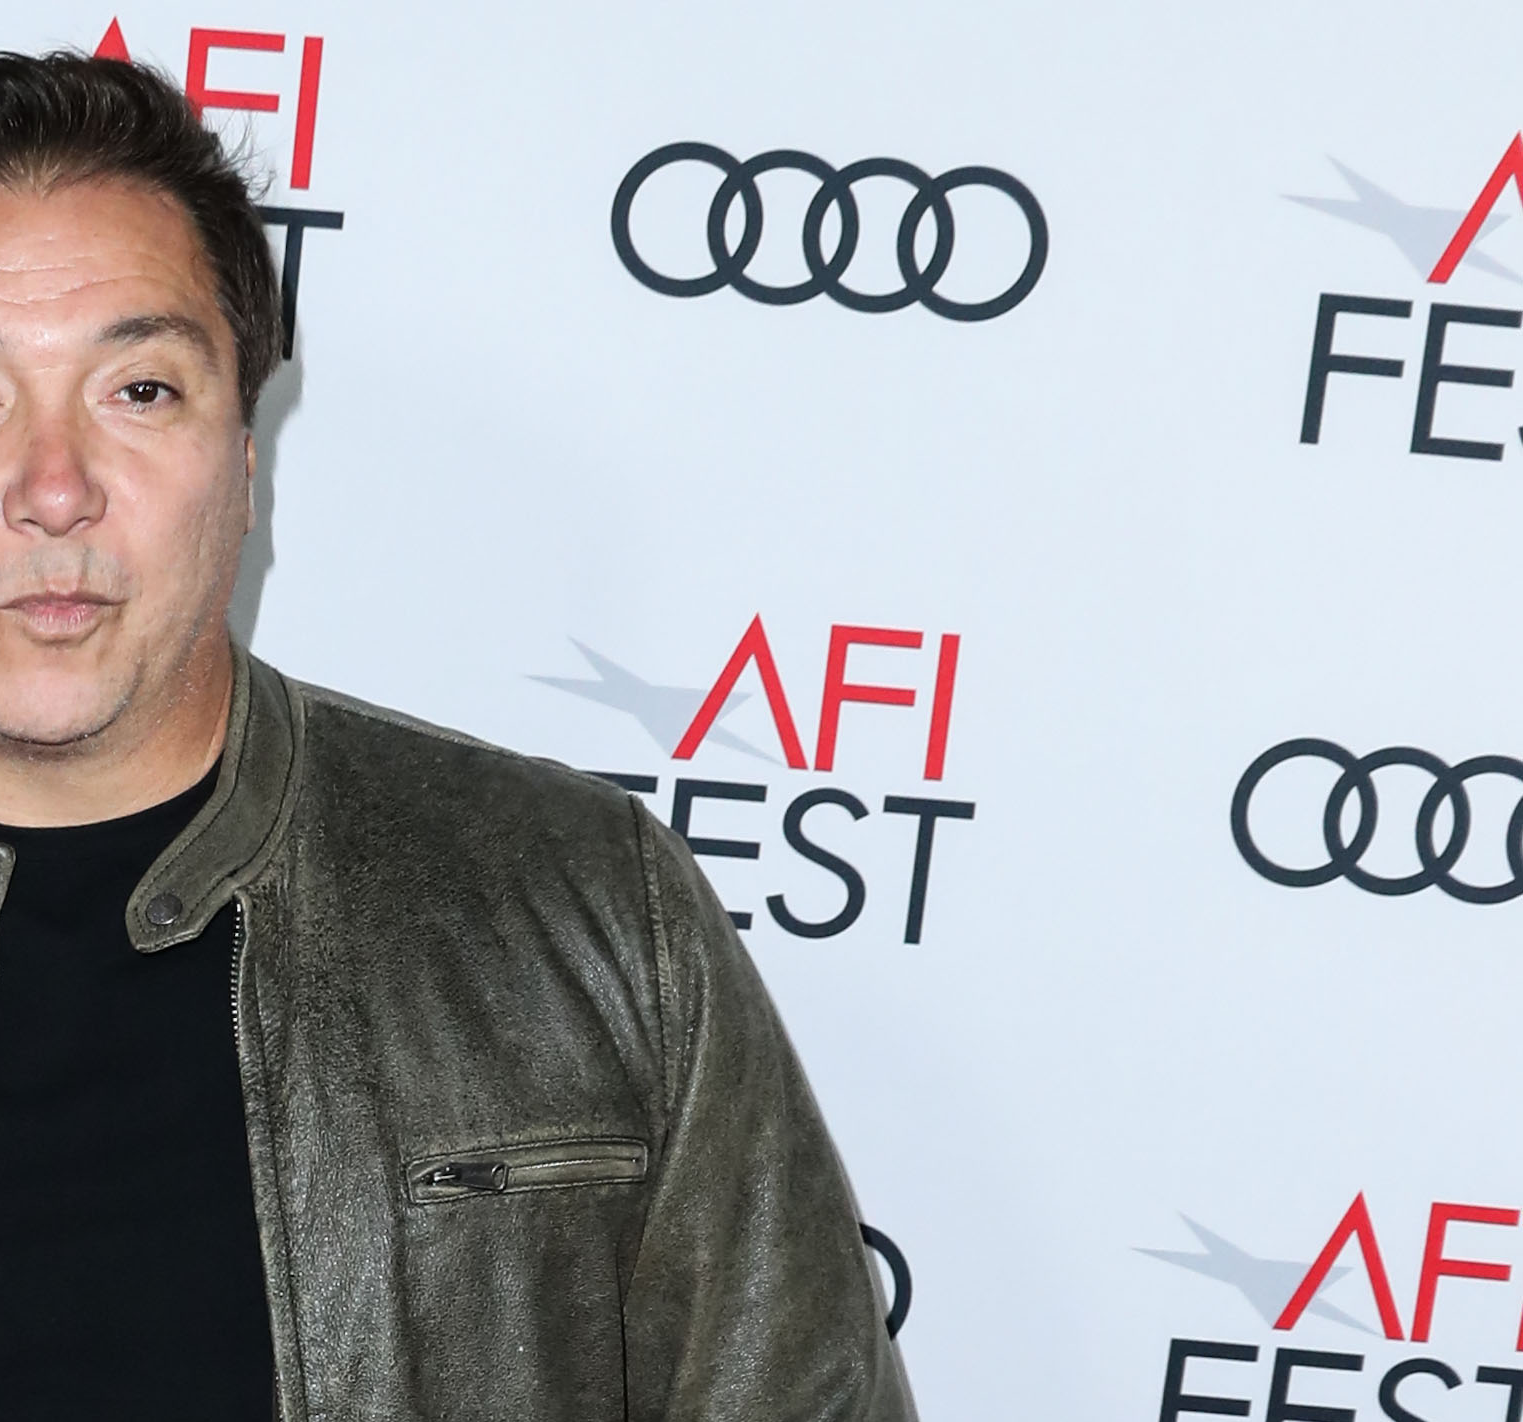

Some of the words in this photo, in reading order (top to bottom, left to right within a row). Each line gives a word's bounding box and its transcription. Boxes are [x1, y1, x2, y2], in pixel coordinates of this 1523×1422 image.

[93, 16, 324, 189] FI
[1299, 292, 1523, 461] FE
[672, 613, 961, 781] AFI
[575, 771, 976, 945] EST
[1275, 1190, 1523, 1352] AF
